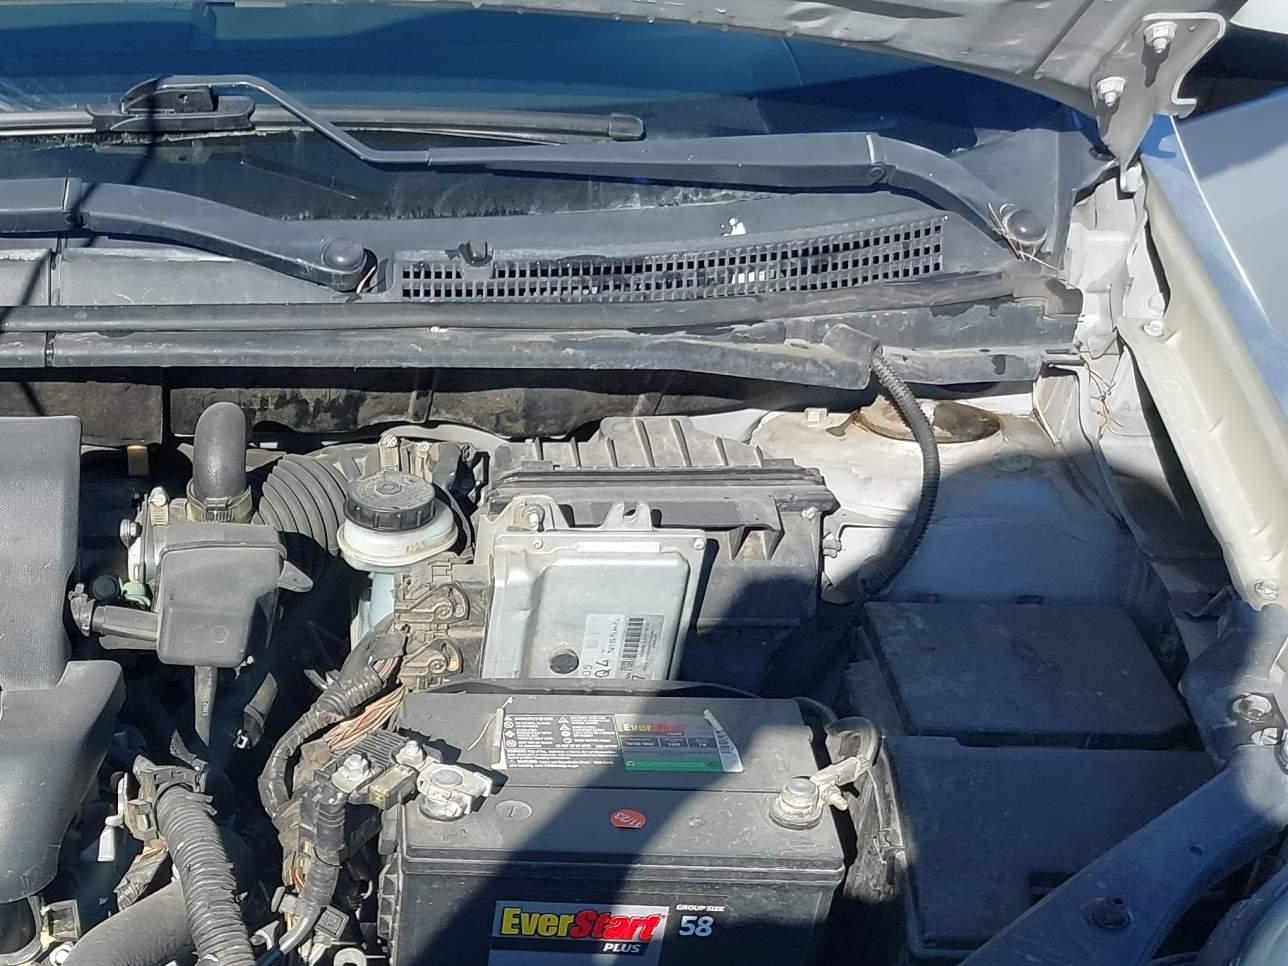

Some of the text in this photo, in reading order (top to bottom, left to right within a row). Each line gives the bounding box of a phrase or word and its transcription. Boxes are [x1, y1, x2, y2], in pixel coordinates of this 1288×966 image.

[675, 903, 705, 912] GROUP
[500, 907, 659, 941] EverStart
[678, 915, 714, 937] 58
[602, 942, 641, 954] PLUS
